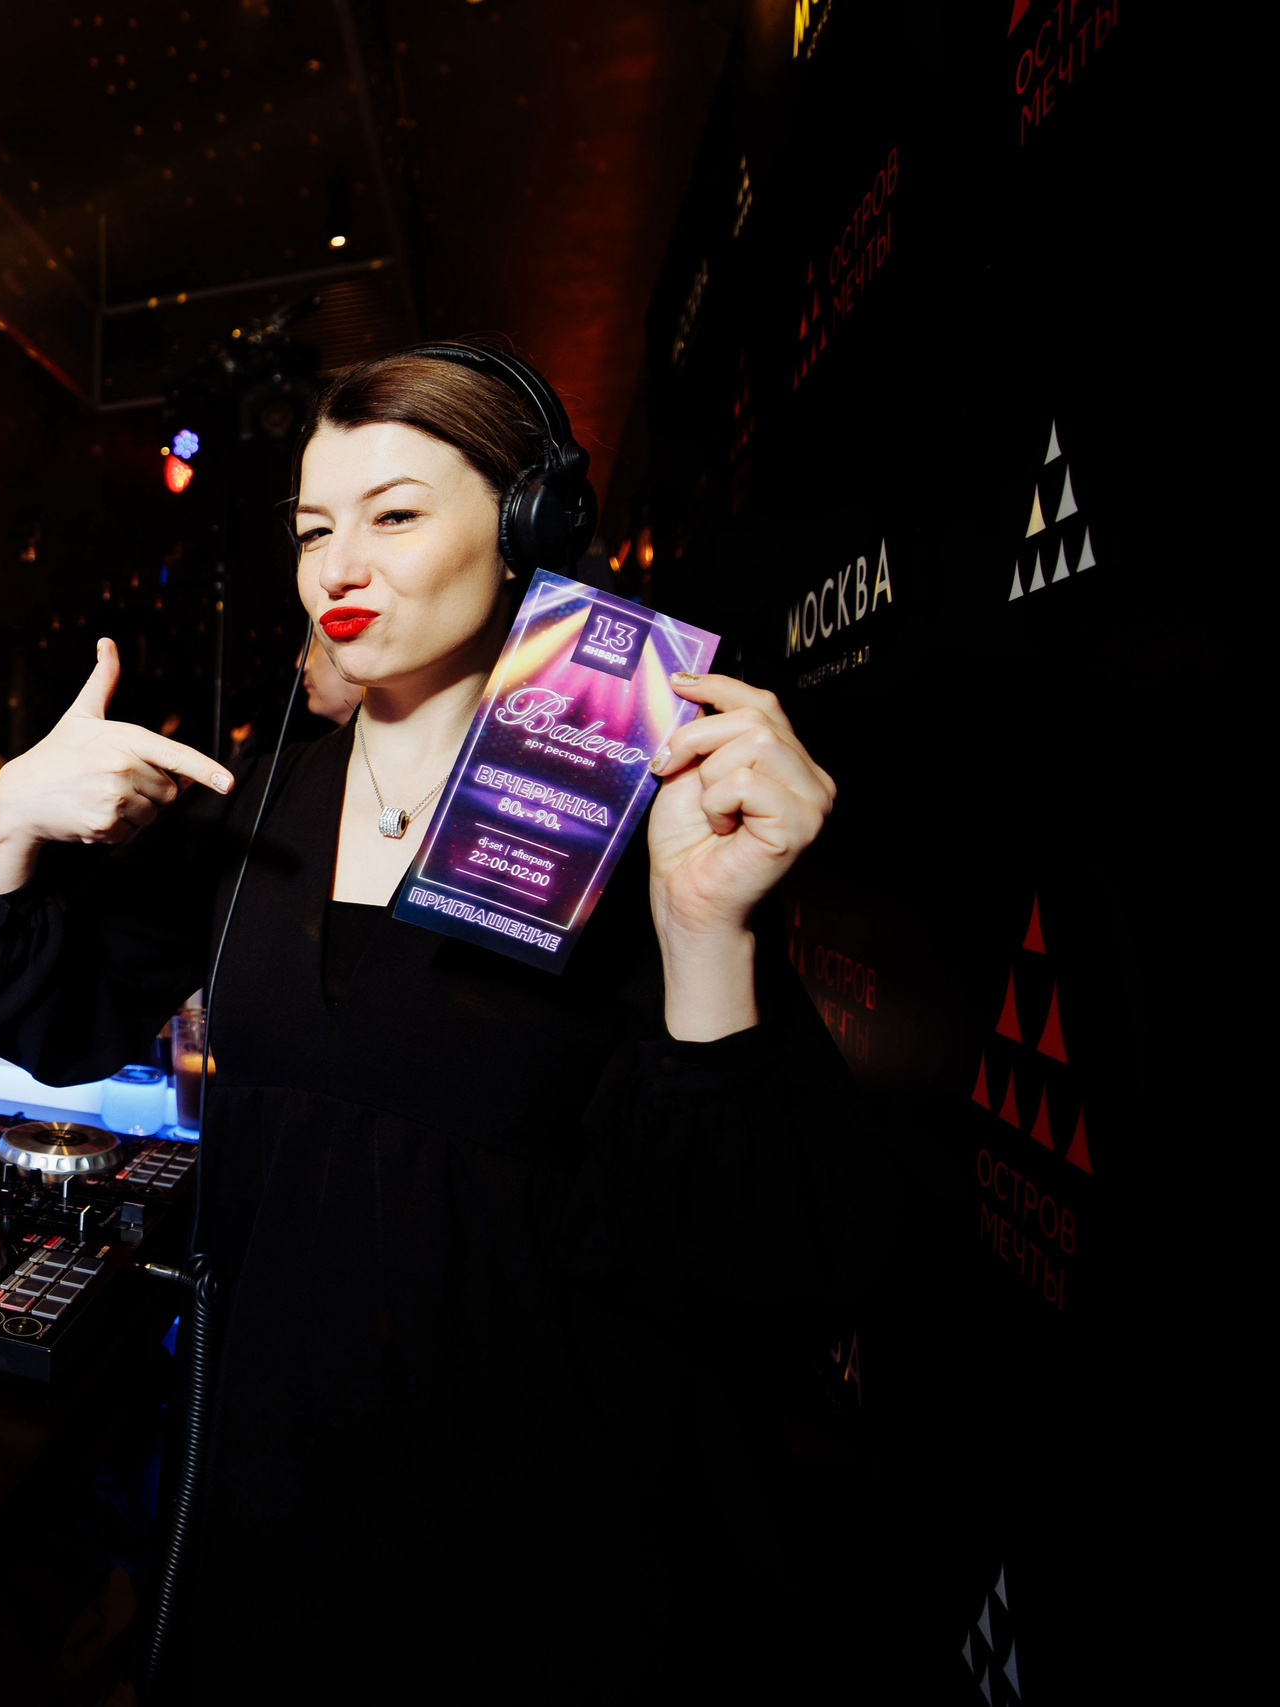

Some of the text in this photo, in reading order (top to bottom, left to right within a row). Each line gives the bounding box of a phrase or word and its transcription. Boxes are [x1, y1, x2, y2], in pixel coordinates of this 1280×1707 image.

[1015, 0, 1080, 95] ОСТР
[827, 146, 900, 286] ОСТРОВ
[832, 211, 893, 332] МЕЧТЫ
[785, 536, 893, 659] МОСКВА
[582, 645, 627, 665] января
[589, 615, 637, 652] 13
[852, 645, 870, 669] ЗАЛ
[495, 687, 650, 764] Baleno
[525, 738, 595, 767] арт ресторан
[474, 765, 608, 826] ВЕЧЕРИНКА
[468, 850, 550, 886] 22:00-02:00
[478, 837, 503, 851] dj-set
[511, 849, 555, 871] afterparty
[408, 886, 562, 953] ПРИГЛАШЕНИЕ
[814, 943, 877, 1011] ОСТРОВ
[976, 1148, 1078, 1256] ОСТРОВ
[978, 1201, 1066, 1313] МЕЧТЫ
